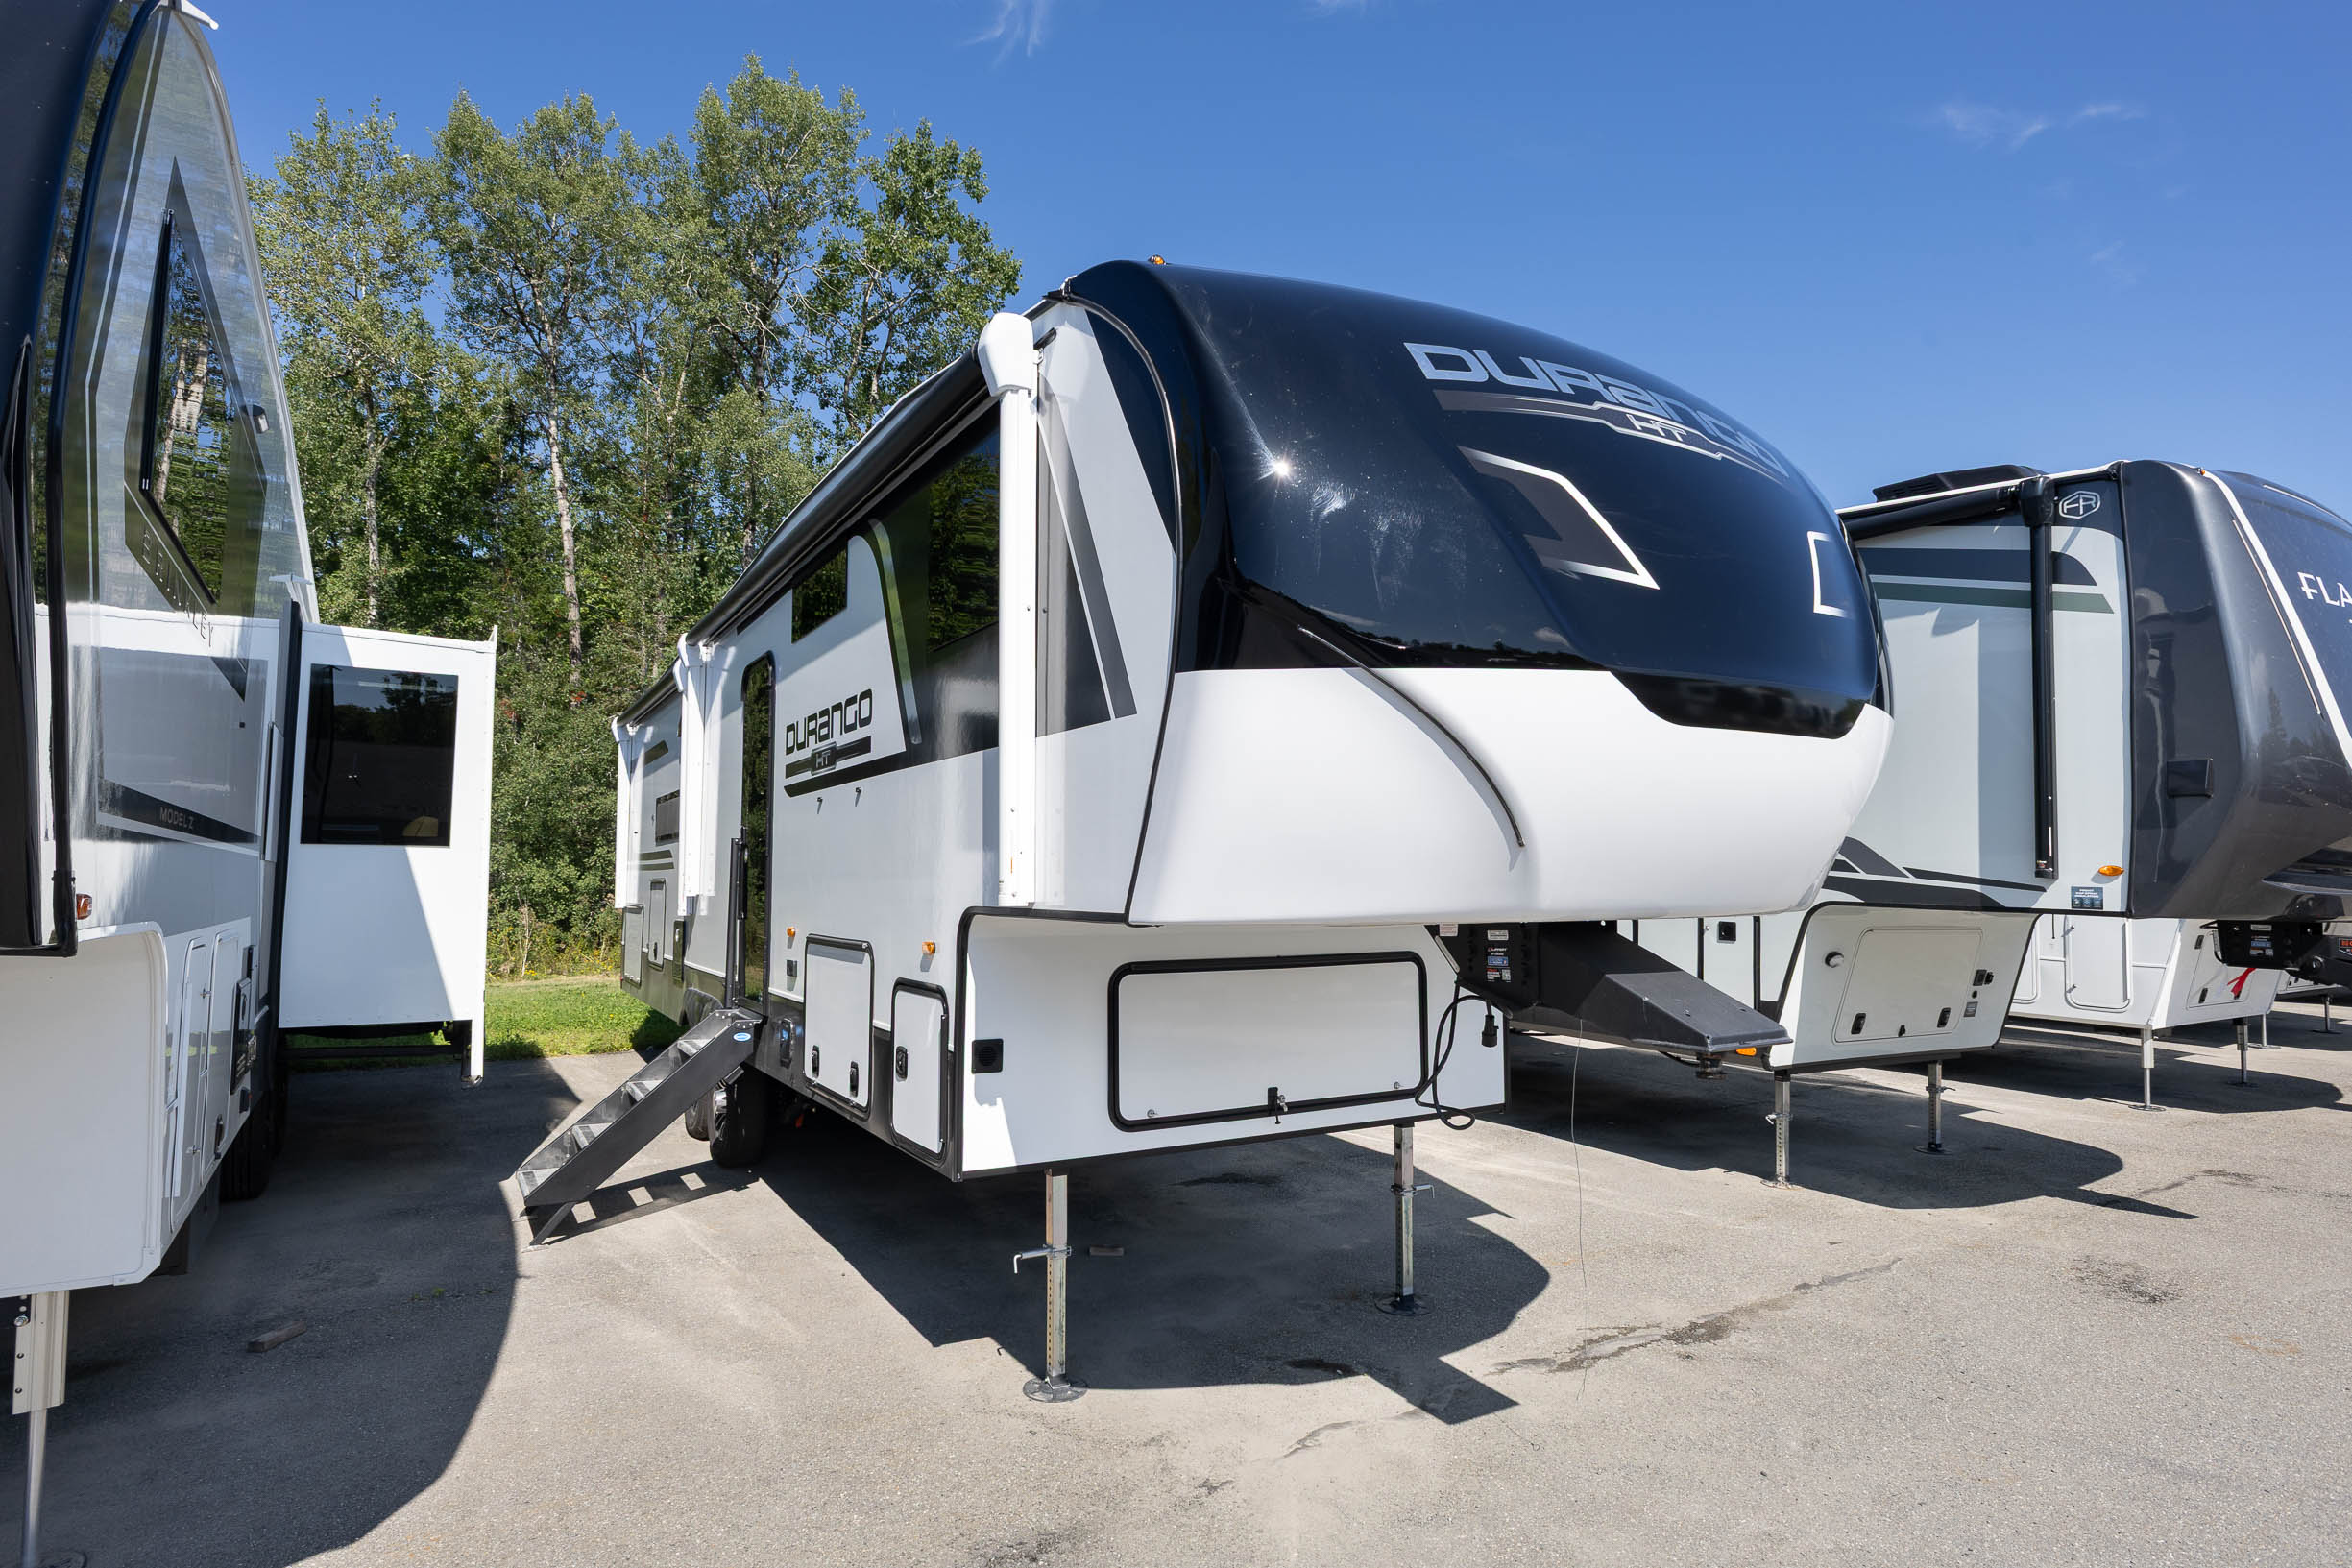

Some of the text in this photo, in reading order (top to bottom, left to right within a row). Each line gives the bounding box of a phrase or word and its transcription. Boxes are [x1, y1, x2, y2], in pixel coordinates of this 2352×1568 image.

[1625, 413, 1687, 442] HT
[816, 749, 831, 768] HT
[161, 807, 187, 828] MODEL
